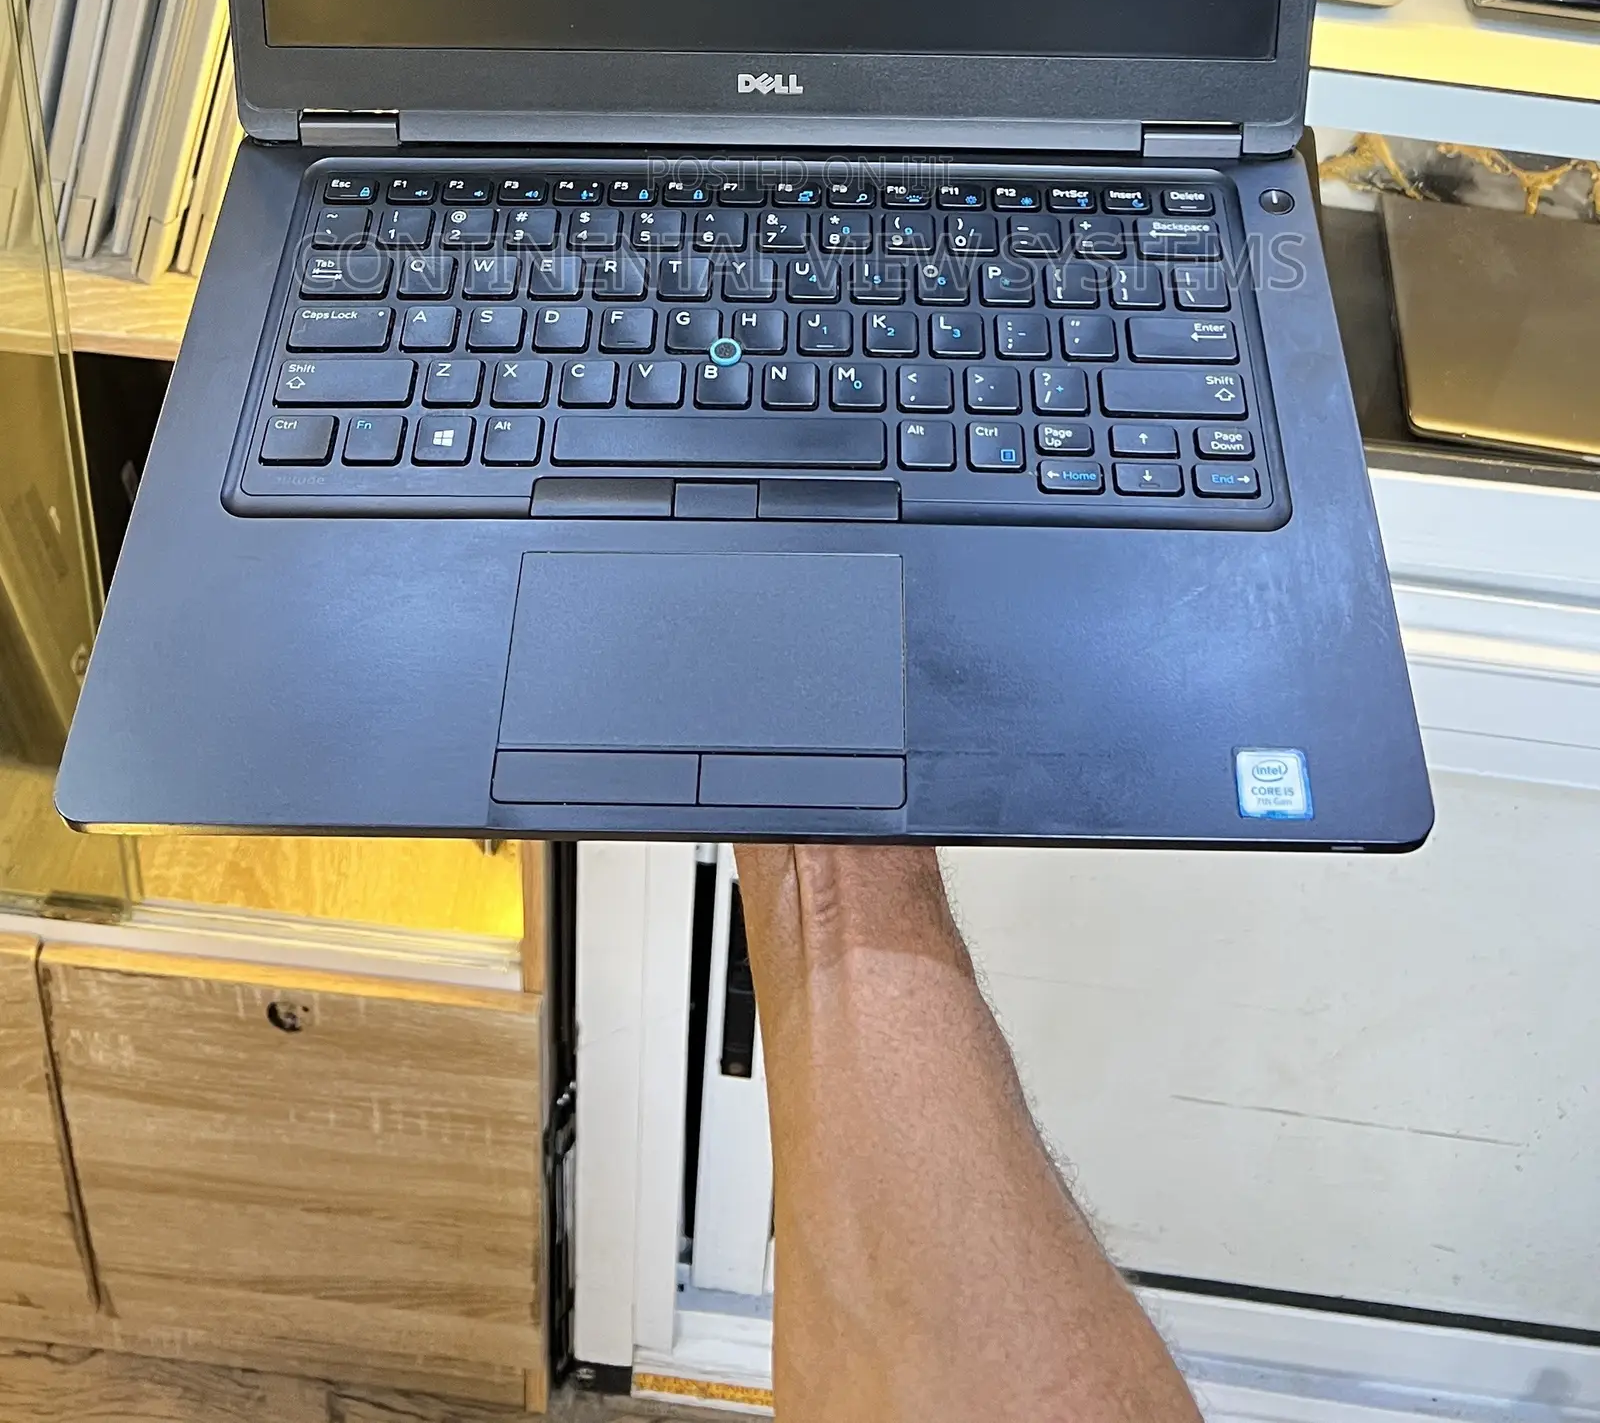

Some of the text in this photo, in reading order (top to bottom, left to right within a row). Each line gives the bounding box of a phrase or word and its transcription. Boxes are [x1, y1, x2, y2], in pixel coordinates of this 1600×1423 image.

[737, 72, 804, 95] DELL
[331, 179, 351, 189] Esc
[393, 180, 407, 189] F1
[449, 180, 464, 189] F2
[504, 180, 519, 190] F3
[559, 181, 574, 190] F4
[614, 181, 629, 190] F5
[669, 182, 683, 191] F6
[723, 183, 738, 192] F7
[778, 183, 793, 192] F8
[833, 184, 847, 193] F9
[887, 185, 906, 194] F10
[942, 186, 959, 195] F11
[997, 188, 1016, 197] F12
[1053, 189, 1089, 199] PrtScr
[1110, 190, 1142, 200] Insert
[1170, 192, 1205, 201] Delete
[393, 211, 398, 222] !
[451, 211, 467, 223] @
[515, 211, 528, 223] #
[579, 212, 591, 224] $
[640, 213, 654, 224] %
[1153, 222, 1210, 232] Backspace
[388, 228, 395, 239] 1
[450, 229, 461, 240] 2
[513, 229, 524, 240] 3
[577, 230, 588, 241] 4
[640, 231, 651, 241] 5
[703, 232, 714, 243] 6
[767, 232, 777, 243] 7
[830, 233, 841, 245] 8
[892, 234, 903, 246] 9
[315, 259, 335, 268] Tab
[411, 260, 424, 273] Q
[473, 260, 494, 272] W
[540, 260, 553, 272] E
[604, 260, 617, 272] R
[669, 261, 681, 273] T
[731, 262, 746, 274] Y
[795, 264, 809, 276] U
[988, 266, 1002, 279] P
[302, 310, 358, 321] Caps Lock
[413, 311, 427, 323] A
[480, 311, 493, 323] S
[545, 311, 560, 324] D
[611, 311, 624, 324] F
[676, 312, 691, 324] G
[741, 313, 756, 326] H
[808, 314, 820, 327] J
[873, 315, 887, 328] K
[940, 316, 952, 329] L
[887, 327, 895, 337] 2
[952, 328, 961, 338] 3
[1194, 323, 1225, 333] Enter
[288, 364, 315, 374] Shift
[437, 364, 450, 377] Z
[503, 365, 517, 377] X
[571, 365, 585, 378] C
[638, 365, 654, 377] V
[704, 366, 718, 379] B
[771, 366, 787, 379] N
[837, 367, 855, 380] M
[1042, 373, 1051, 386] ?
[1206, 376, 1234, 386] Shift
[275, 420, 297, 430] Ctrl
[357, 420, 372, 430] Fn
[494, 421, 512, 430] Alt
[907, 425, 924, 435] Alt
[975, 426, 998, 436] Ctrl
[1044, 428, 1073, 439] Page
[1045, 437, 1062, 447] Up
[1214, 432, 1243, 443] Page
[1211, 441, 1244, 451] Down
[1063, 471, 1097, 481] Home
[1211, 474, 1235, 484] End
[1251, 786, 1282, 796] CORE
